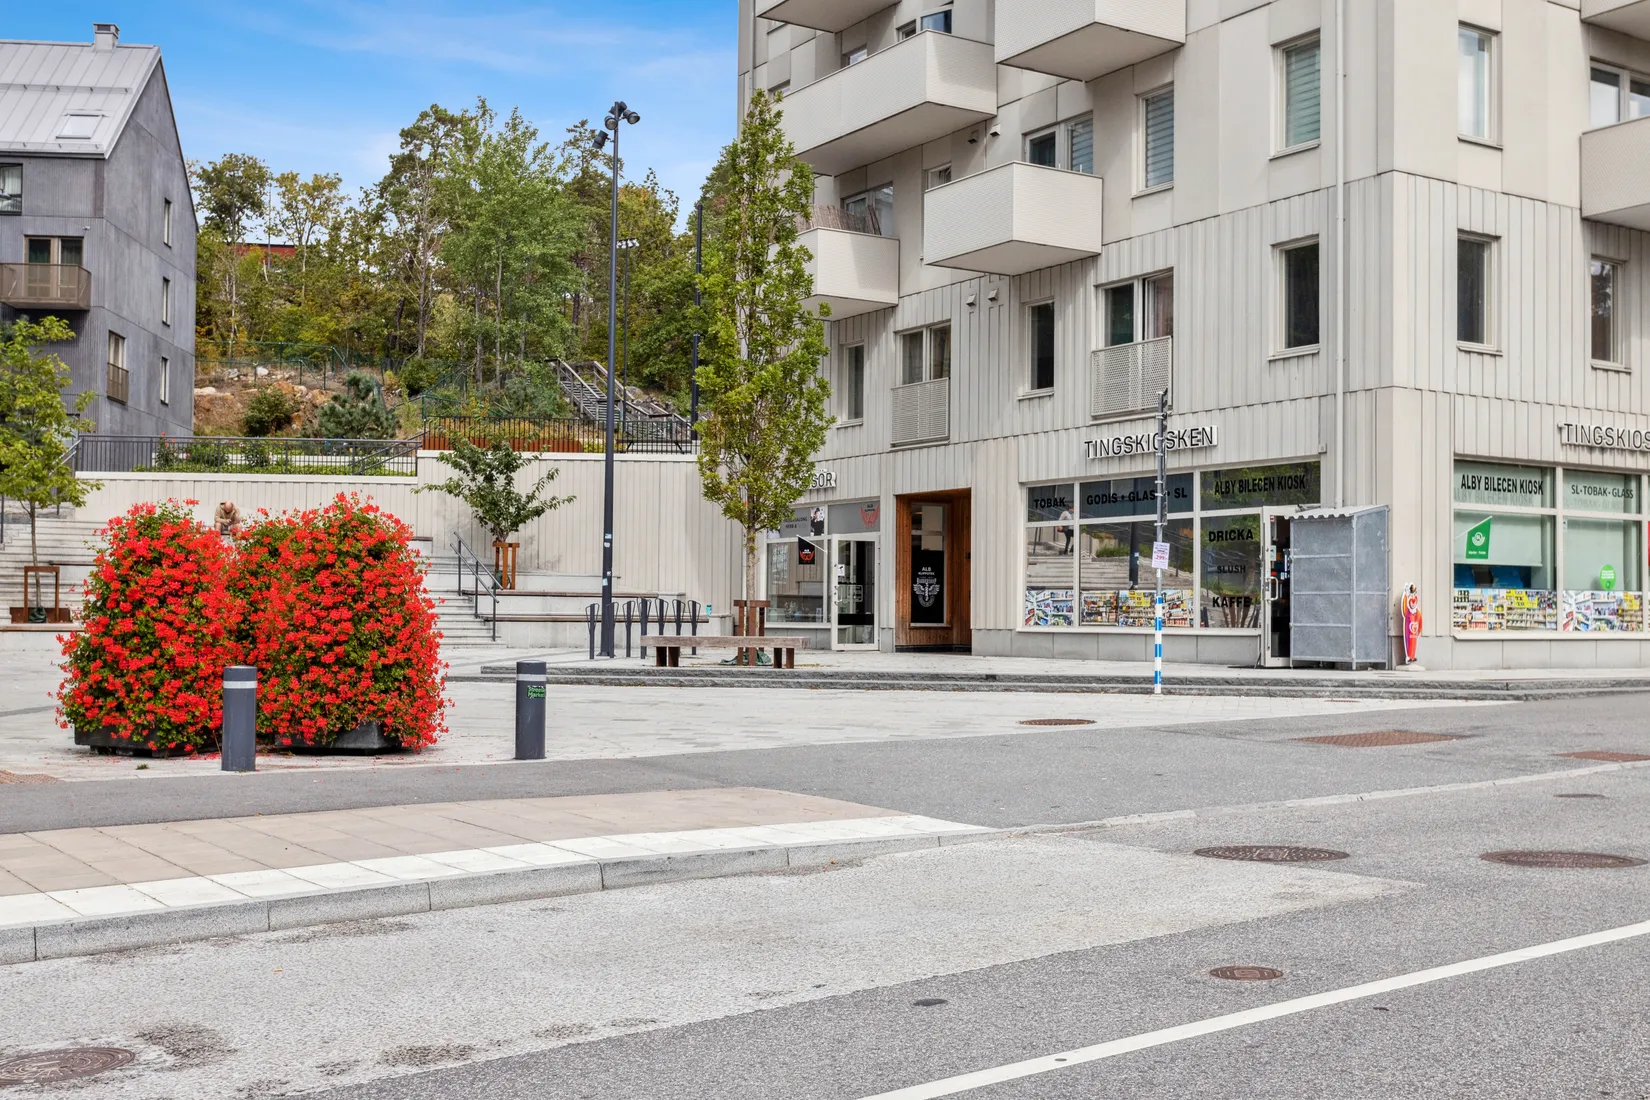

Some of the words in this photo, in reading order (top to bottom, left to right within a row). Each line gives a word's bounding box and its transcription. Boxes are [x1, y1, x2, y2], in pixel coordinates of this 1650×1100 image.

[1084, 426, 1213, 458] TINGSKIOSKEN
[1214, 480, 1237, 495] ALBY
[1277, 475, 1306, 491] KIOSK
[1460, 474, 1482, 491] ALBY
[1484, 476, 1518, 493] BILECEN
[1519, 479, 1544, 495] KIOSK
[1033, 497, 1066, 509] TOBAK
[1086, 493, 1118, 506] GODIS
[1128, 490, 1158, 502] GLAS
[1173, 487, 1188, 499] SL
[1208, 528, 1254, 543] DRICKA
[1216, 565, 1246, 574] SLUSH
[1212, 596, 1252, 608] KAFFE
